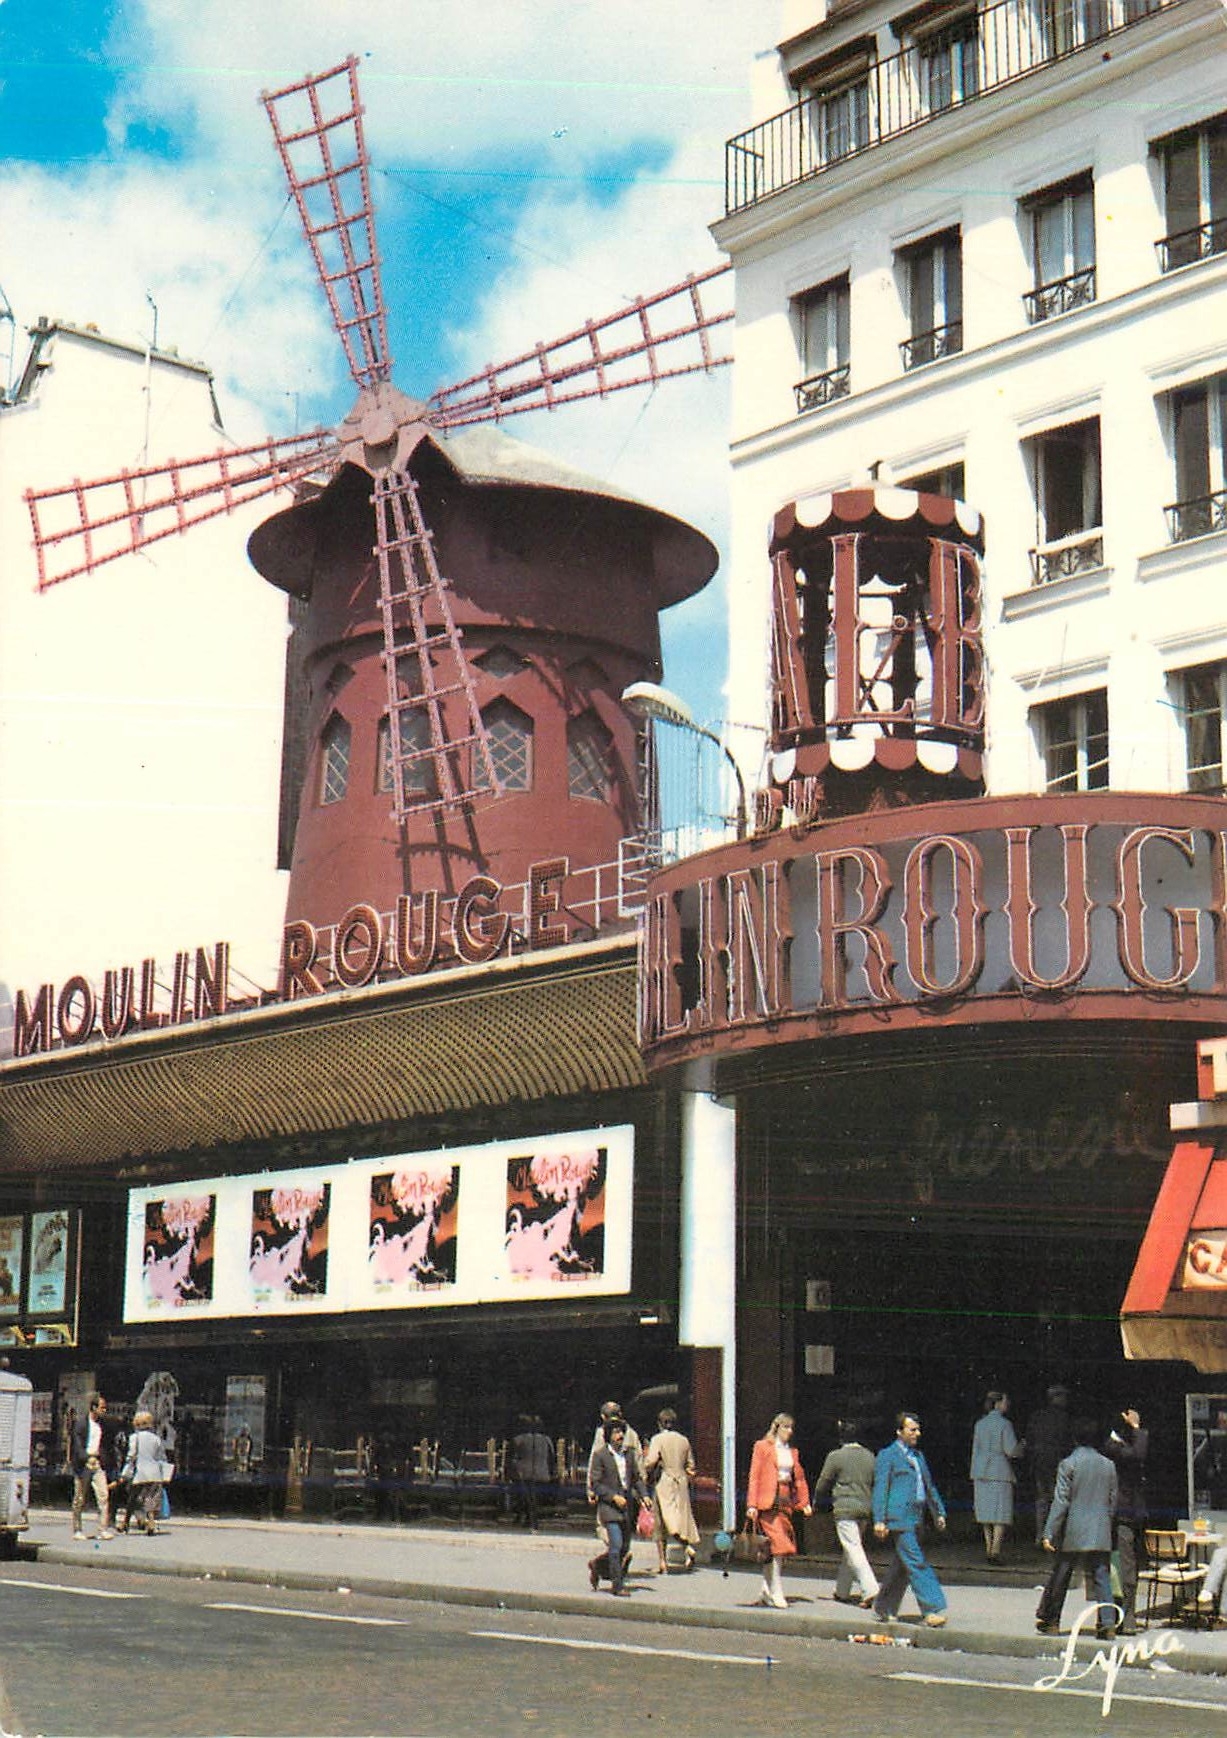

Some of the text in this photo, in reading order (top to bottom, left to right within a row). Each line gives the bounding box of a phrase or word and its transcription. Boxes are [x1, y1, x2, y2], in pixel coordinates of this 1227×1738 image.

[14, 857, 569, 1057] MOULIN ROUGE
[815, 823, 1227, 1008] ROUG
